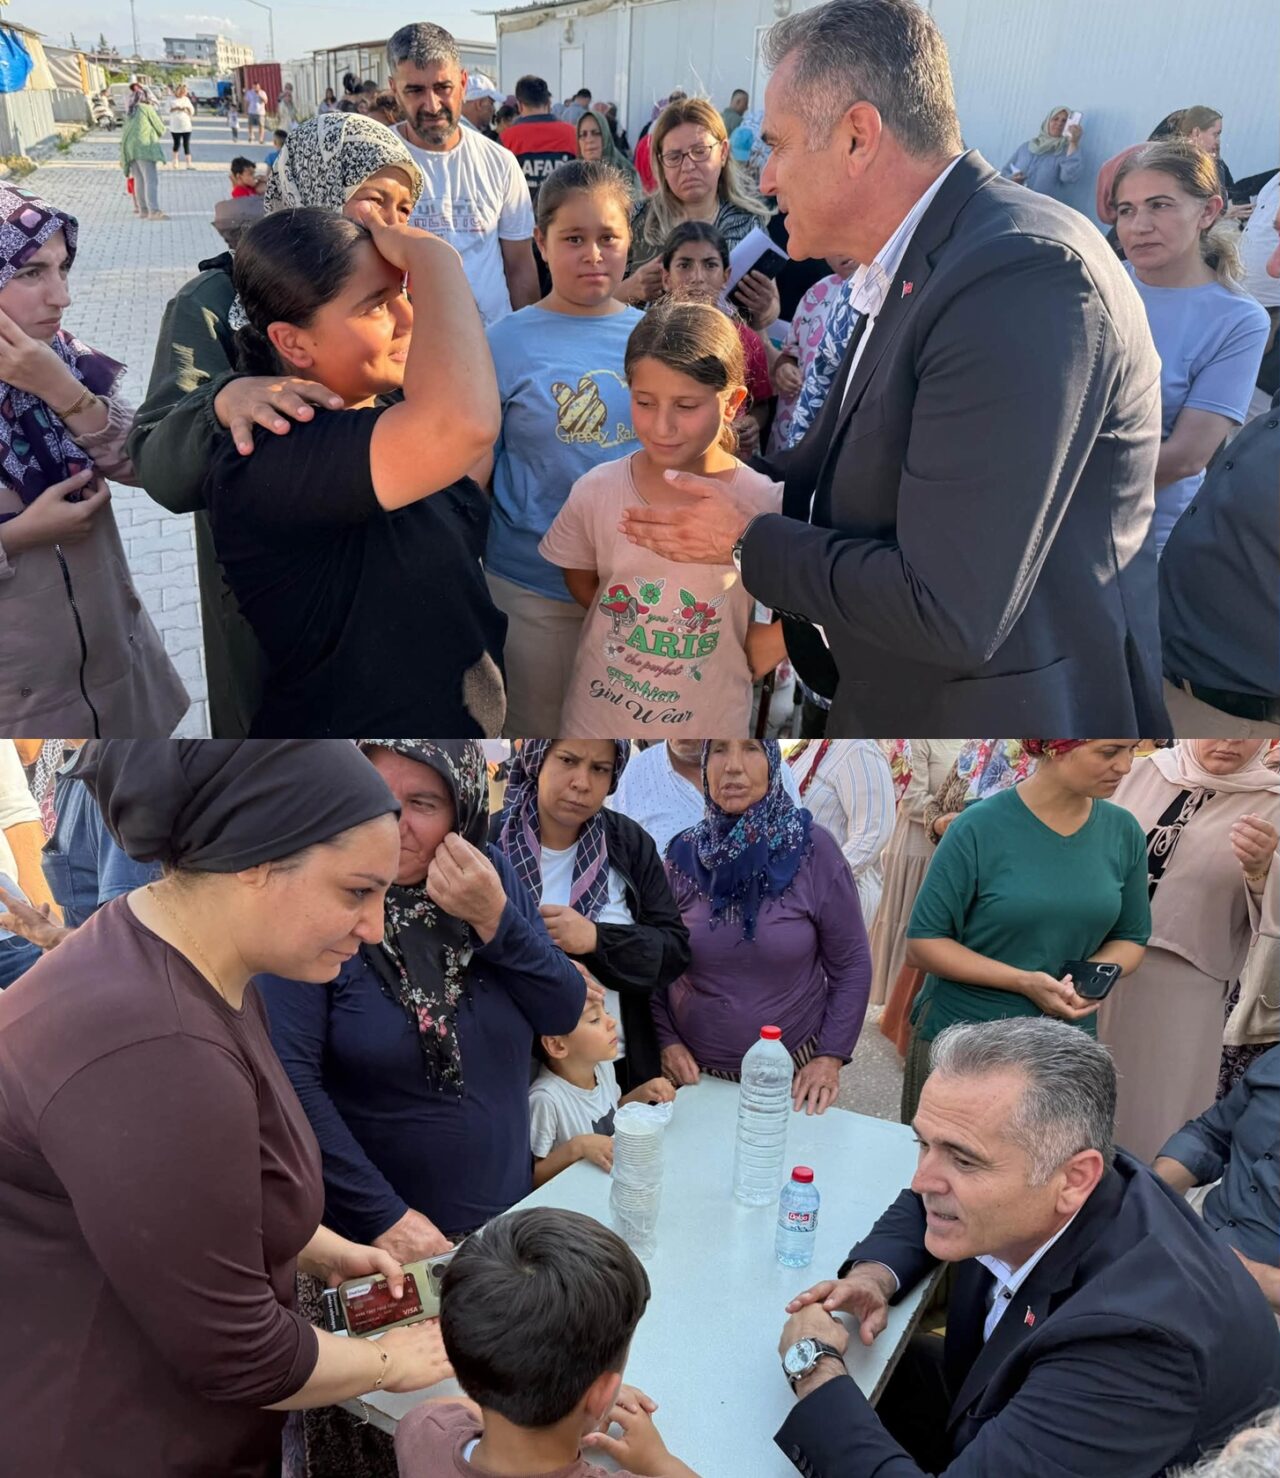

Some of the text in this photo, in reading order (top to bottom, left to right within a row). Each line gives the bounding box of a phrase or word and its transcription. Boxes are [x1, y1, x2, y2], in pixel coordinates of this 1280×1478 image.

[616, 422, 638, 442] Rab
[624, 653, 642, 667] the
[607, 666, 680, 703] Fashion
[589, 679, 693, 724] Girl Wear
[402, 1306, 419, 1316] VISA
